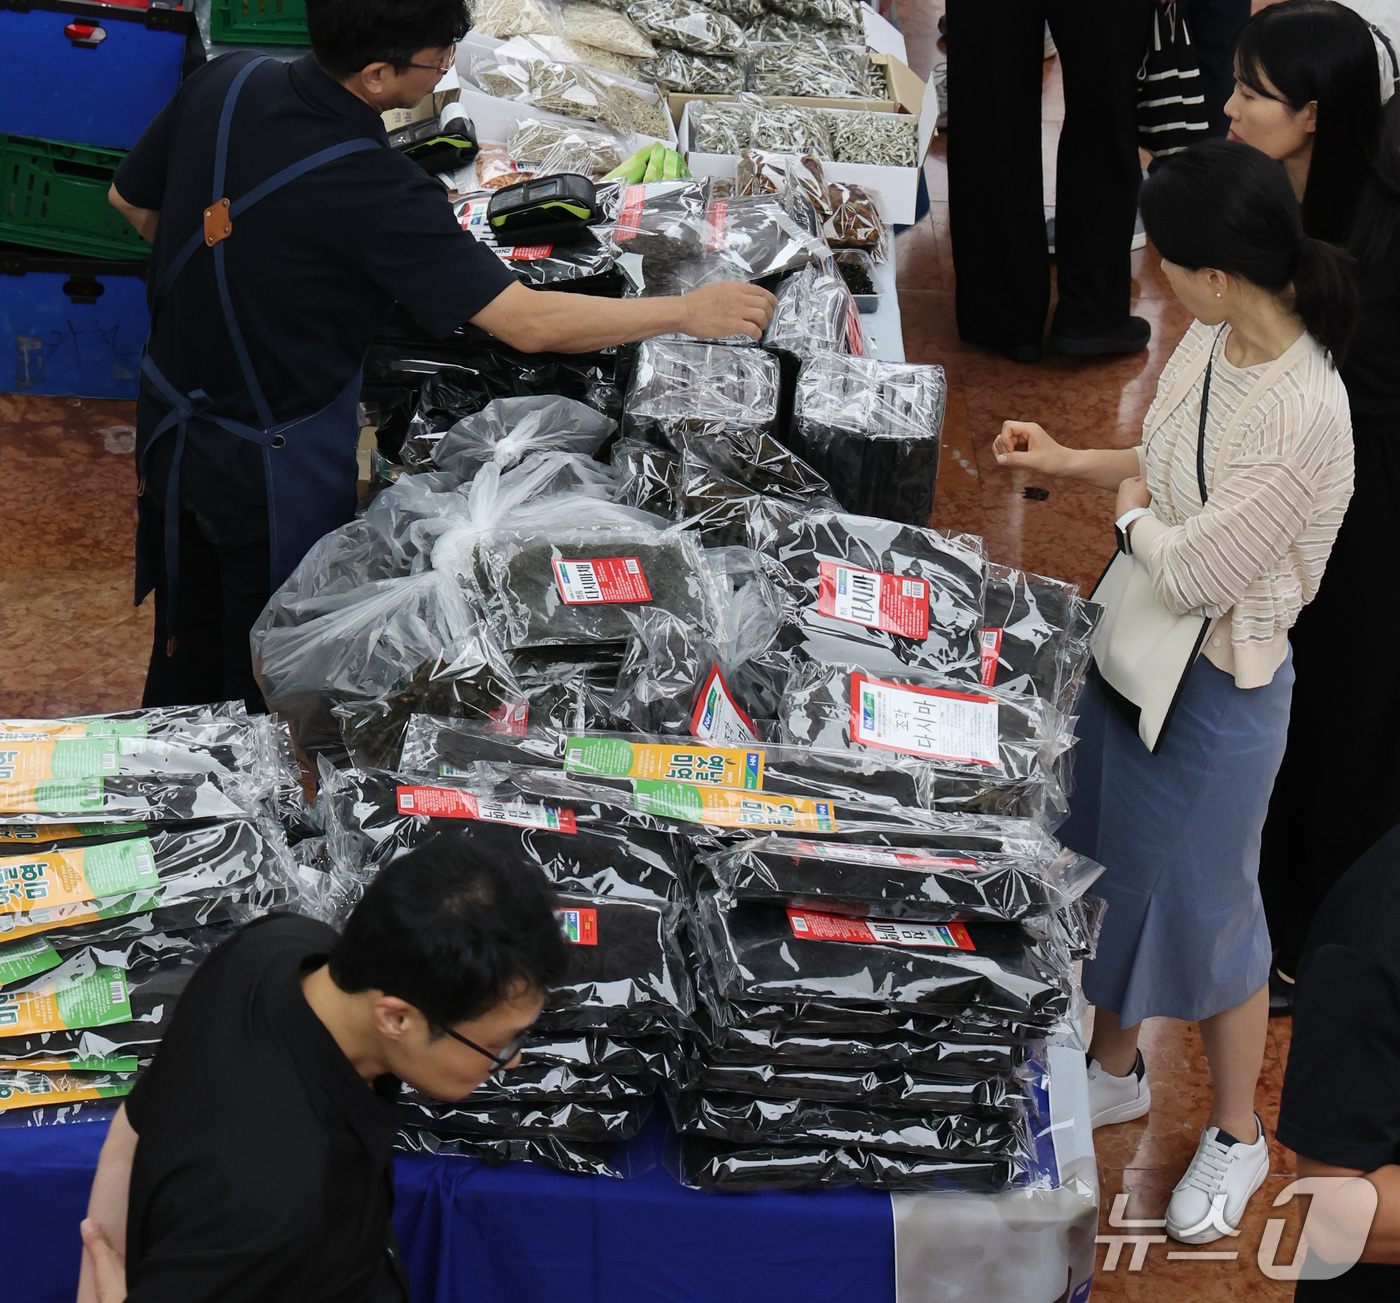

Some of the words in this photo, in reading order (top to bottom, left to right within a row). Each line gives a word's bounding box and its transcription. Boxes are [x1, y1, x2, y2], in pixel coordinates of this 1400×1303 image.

[575, 564, 600, 600] 다시마채
[851, 574, 876, 622] 다시마
[703, 713, 712, 729] NH
[865, 717, 873, 729] NH
[893, 709, 911, 732] 조각
[913, 700, 937, 749] 다시마
[664, 753, 695, 779] 미역
[695, 753, 726, 784] 옛날
[749, 755, 756, 767] NH
[819, 804, 826, 816] NH
[23, 862, 49, 900] 미역
[873, 924, 903, 943] 미역
[901, 929, 927, 941] 참
